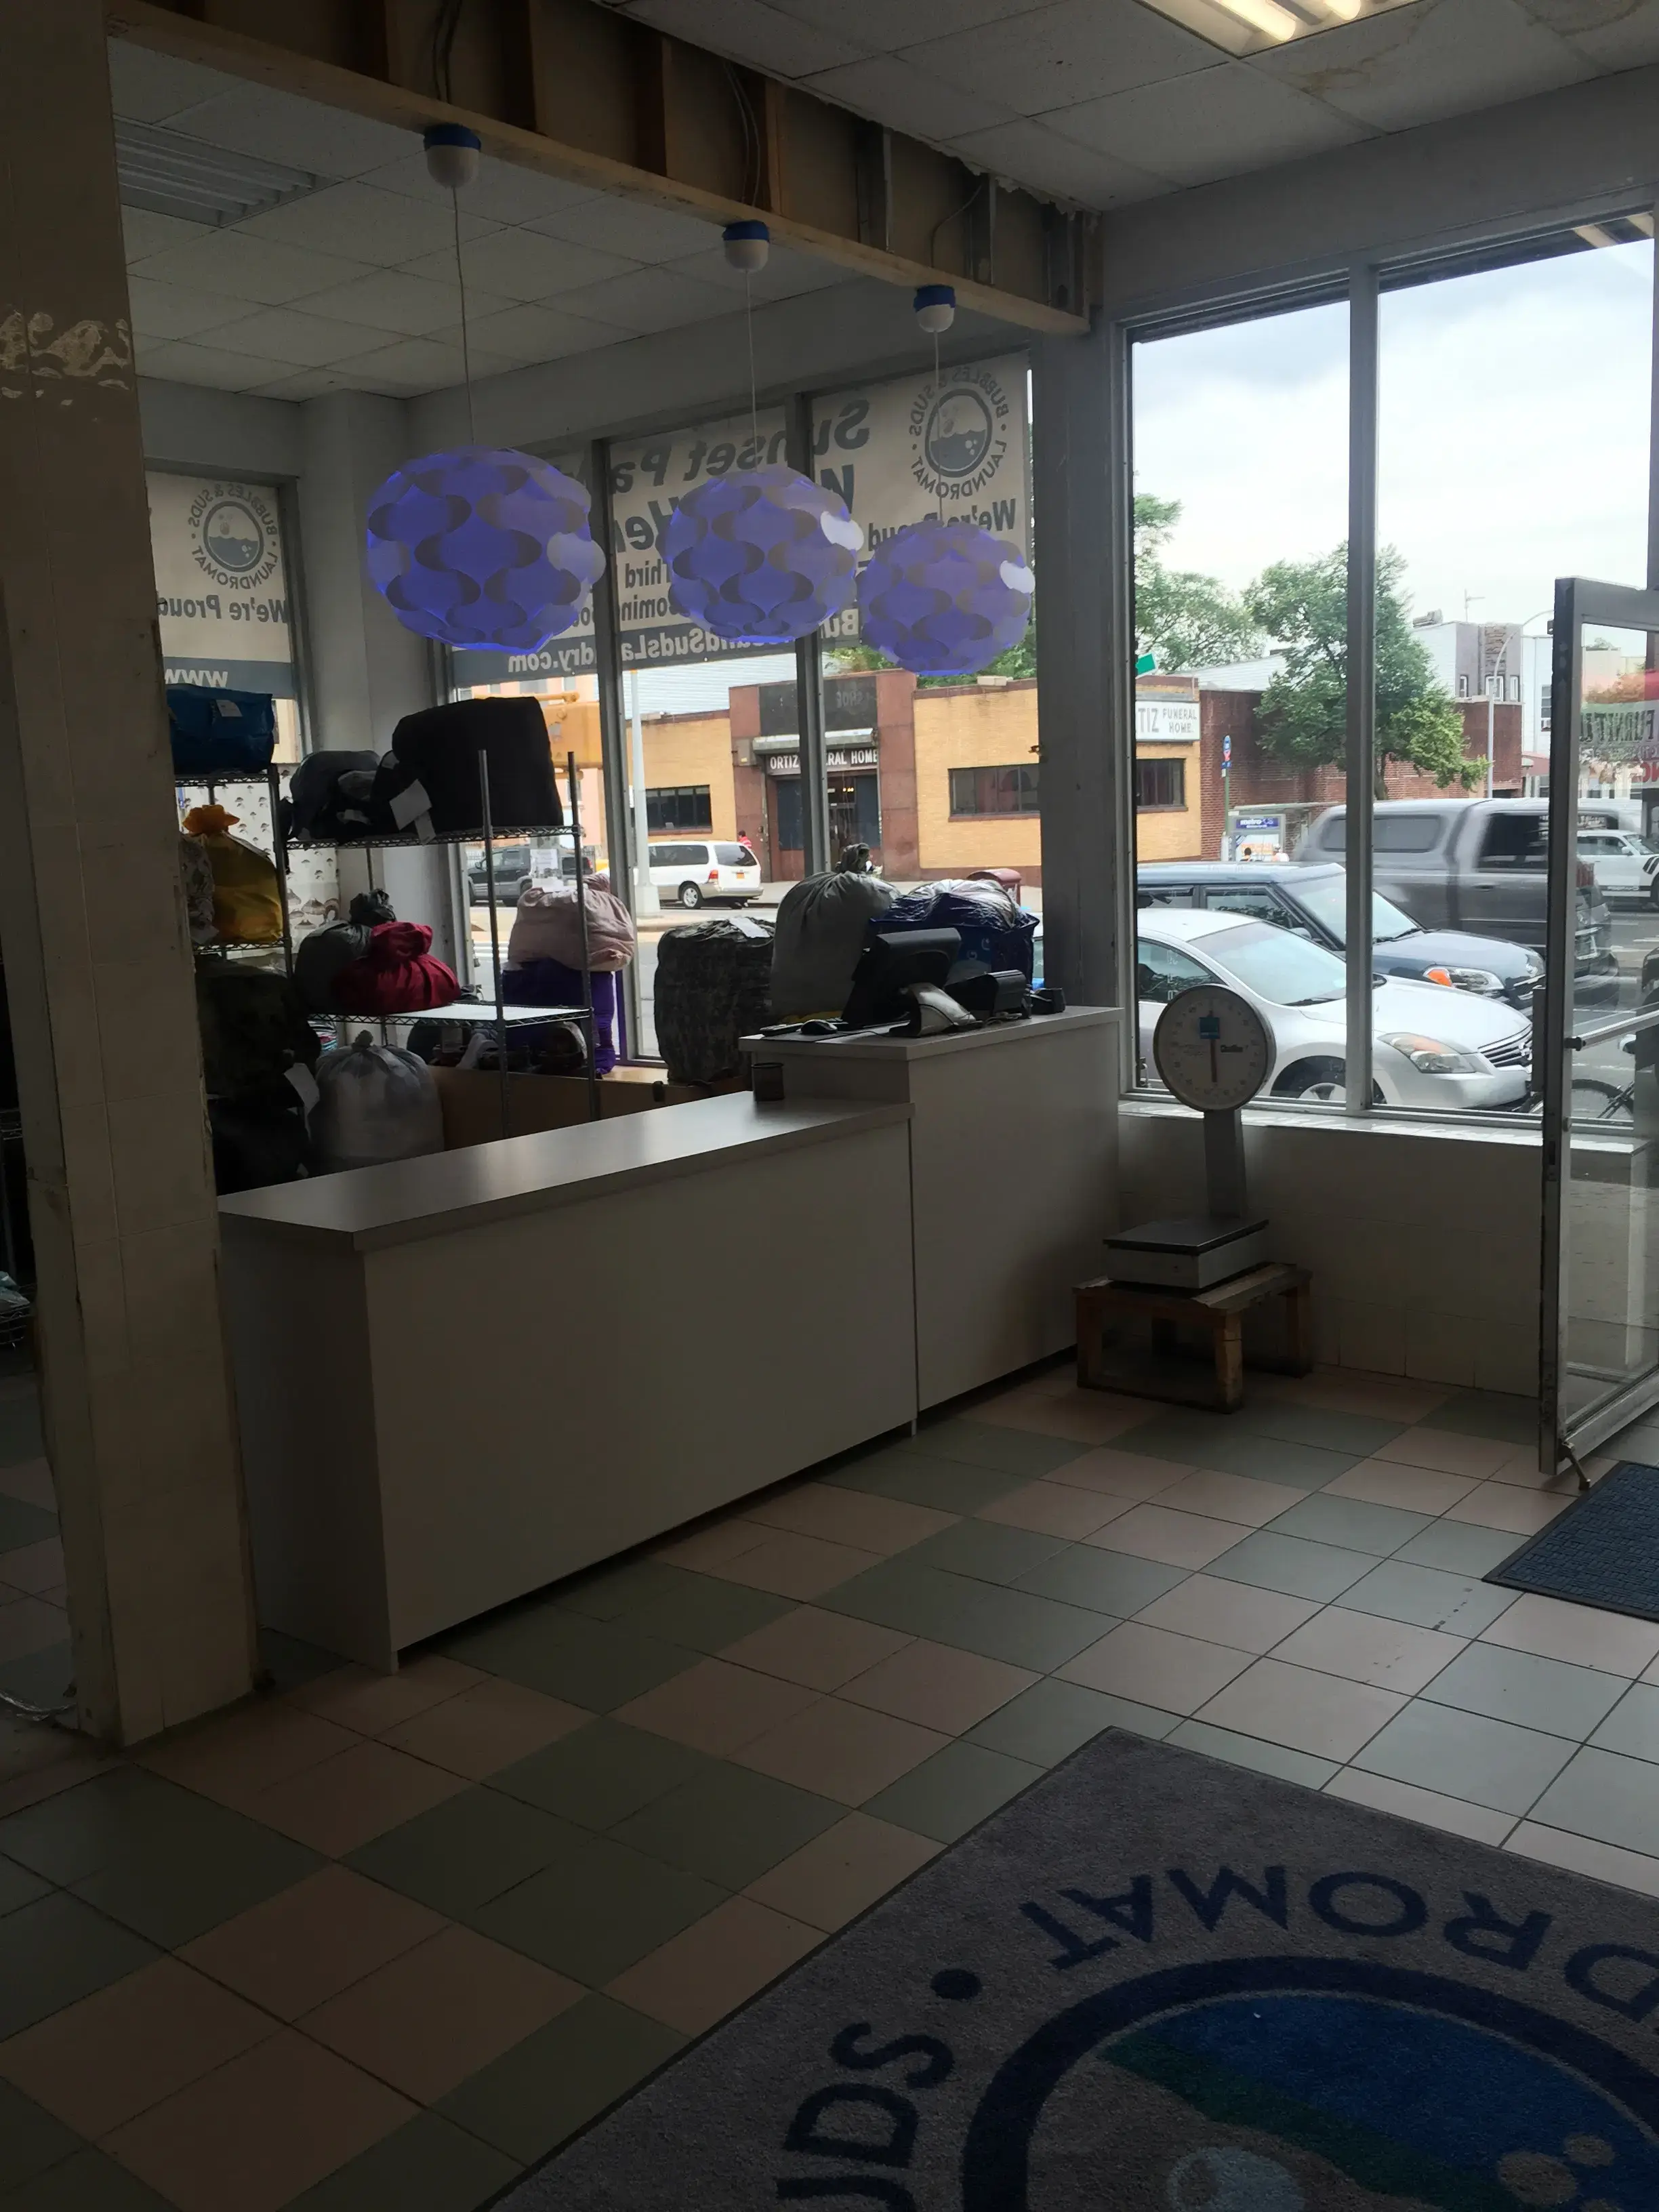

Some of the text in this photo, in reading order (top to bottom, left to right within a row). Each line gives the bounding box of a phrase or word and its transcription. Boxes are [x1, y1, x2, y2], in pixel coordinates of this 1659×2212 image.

[1137, 708, 1160, 733] TIZ
[1162, 708, 1197, 720] FUNERAL
[770, 754, 800, 770] ORTIZ
[851, 749, 878, 764] HOME
[1018, 1865, 1659, 2023] DROMAT
